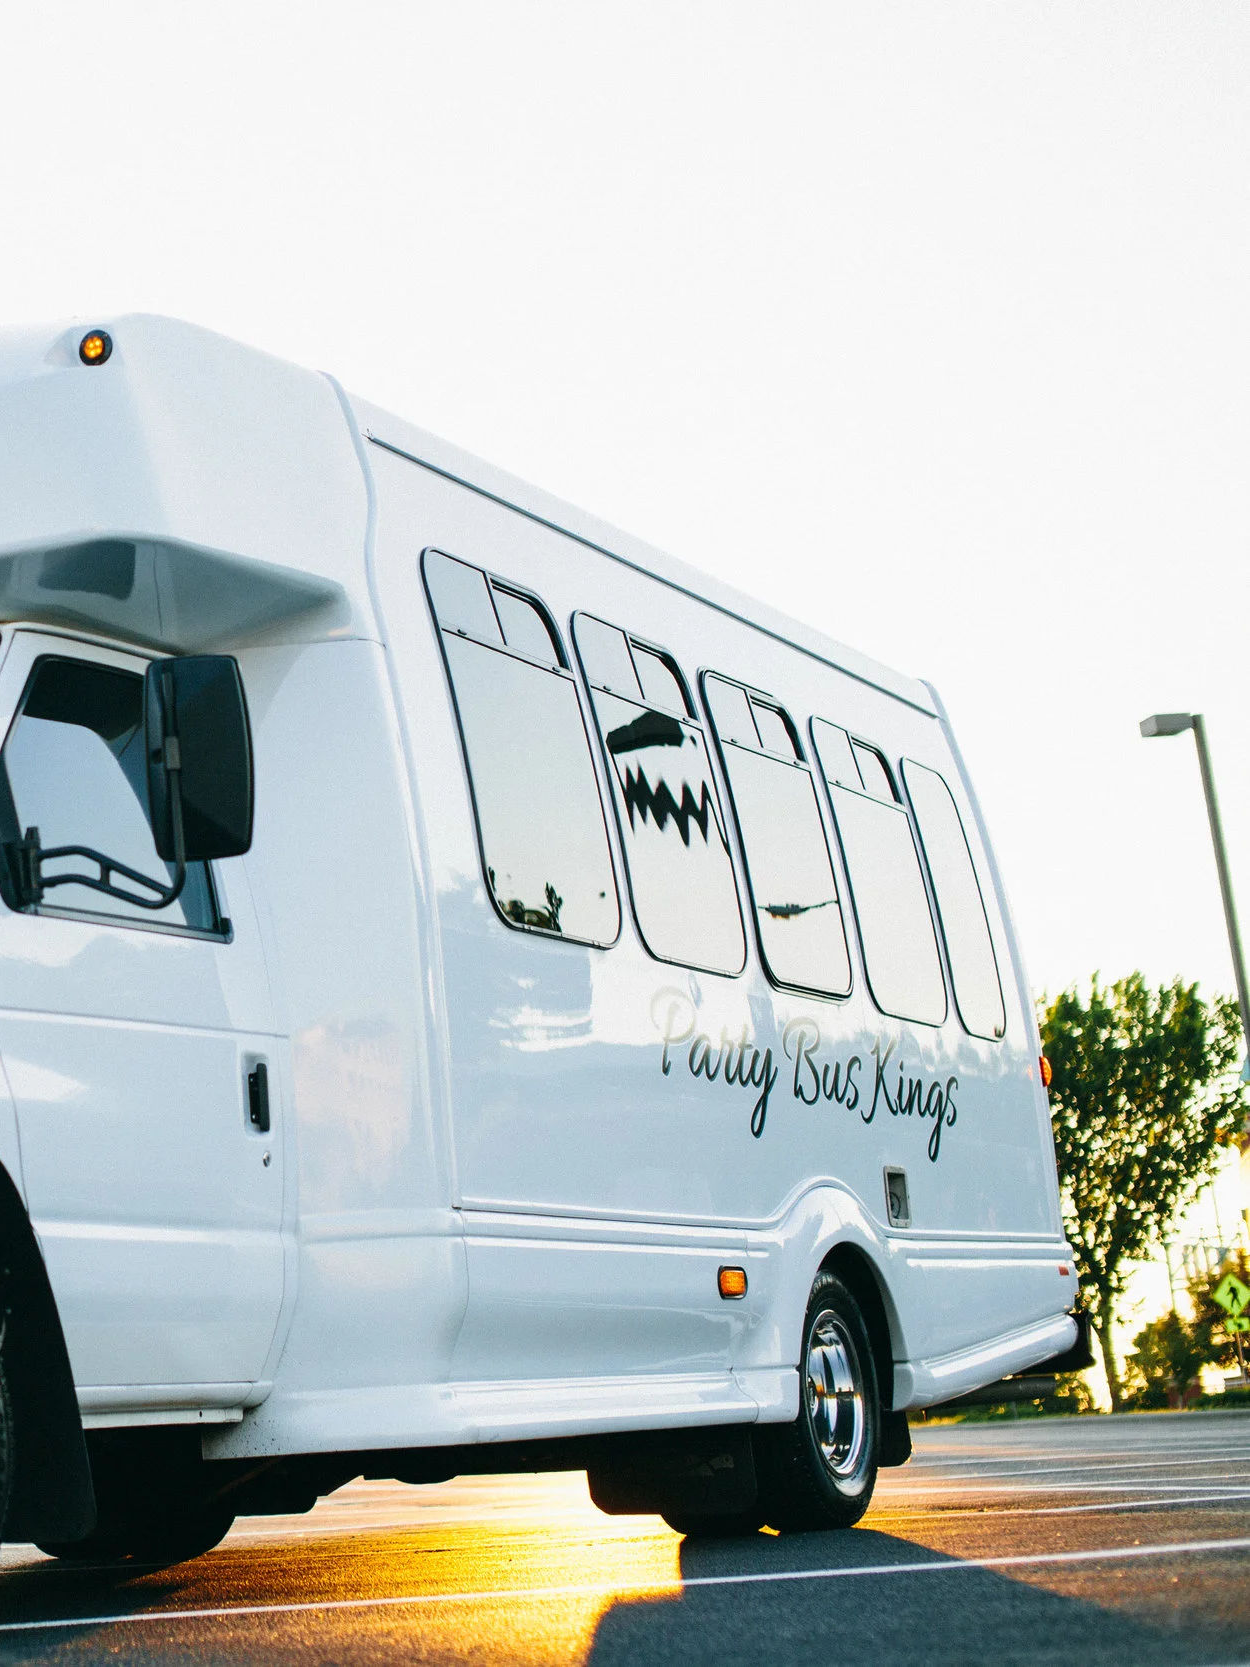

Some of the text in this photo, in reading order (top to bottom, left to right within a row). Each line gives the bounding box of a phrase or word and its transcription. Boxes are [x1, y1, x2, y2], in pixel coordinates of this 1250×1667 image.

[650, 986, 959, 1162] Party Bus Kings
